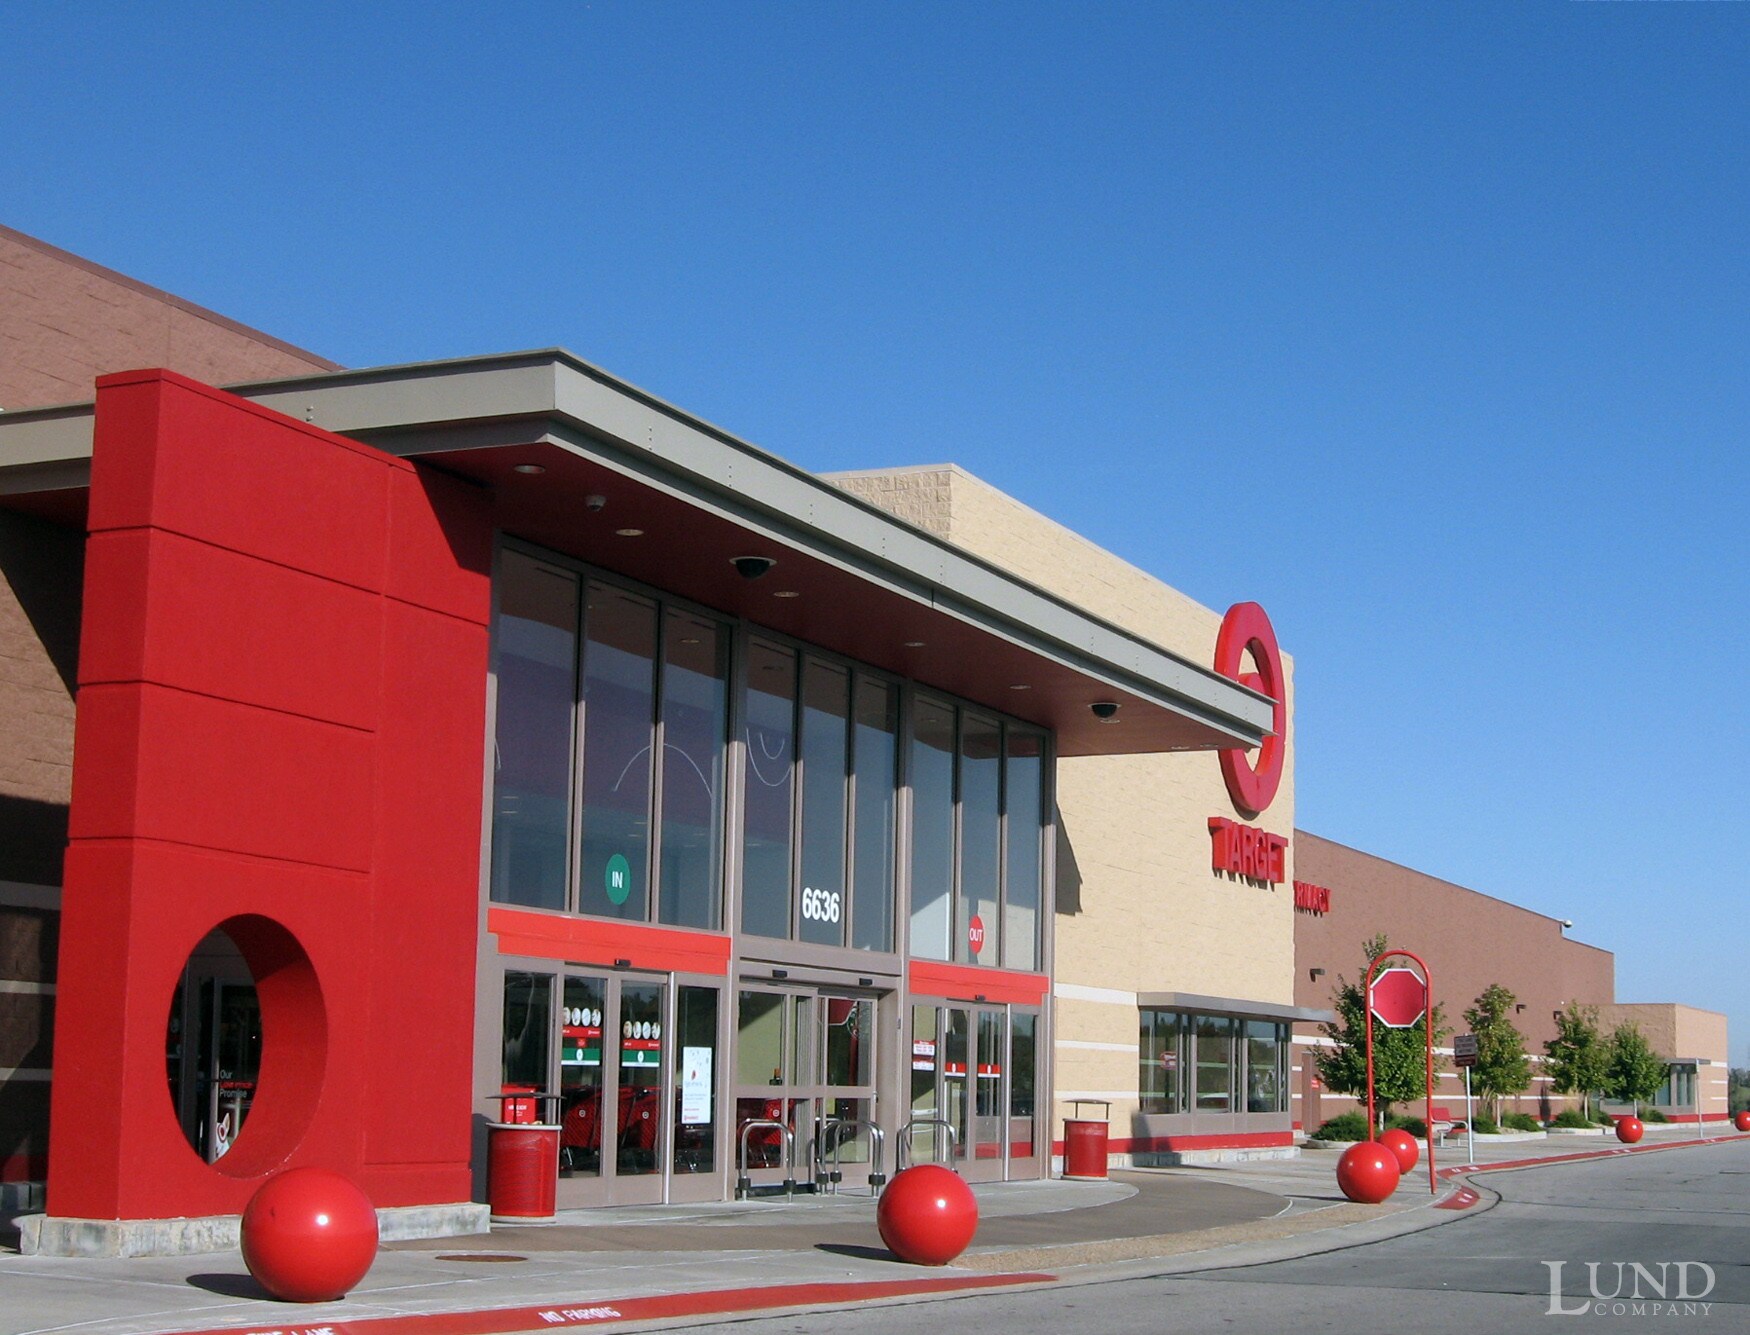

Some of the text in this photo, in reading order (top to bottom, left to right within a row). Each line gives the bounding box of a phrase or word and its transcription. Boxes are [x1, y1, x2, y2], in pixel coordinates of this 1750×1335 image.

[1207, 816, 1288, 883] TARGET
[612, 871, 623, 888] IN
[802, 887, 840, 923] 6636
[969, 928, 983, 942] OUT
[538, 1307, 621, 1323] NO PARKING
